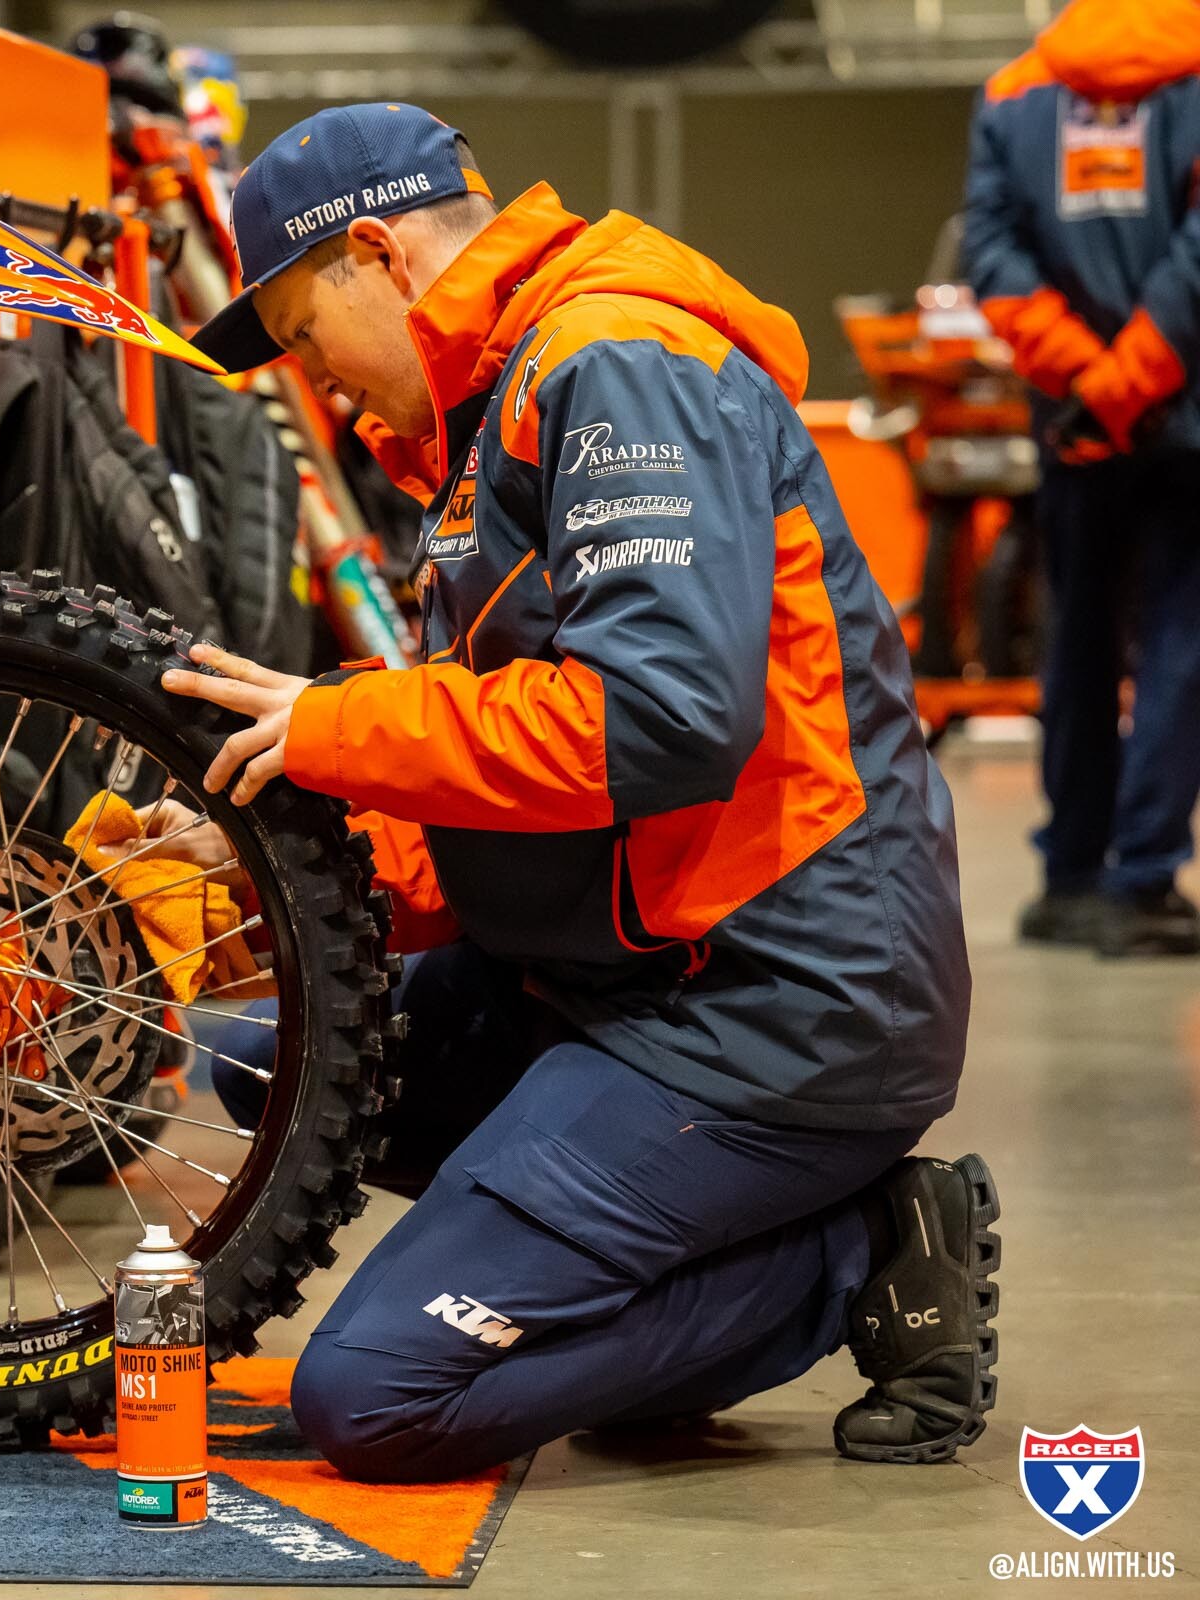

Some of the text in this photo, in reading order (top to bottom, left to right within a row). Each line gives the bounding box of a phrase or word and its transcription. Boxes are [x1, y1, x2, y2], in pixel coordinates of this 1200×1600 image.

[284, 172, 432, 240] FACTORY RACING
[558, 422, 685, 475] PARADISE
[588, 460, 685, 478] CHEVROLET CADILLAC
[596, 496, 692, 517] RENTHAL
[637, 508, 689, 516] CHAMPIONSHIPS
[428, 537, 458, 554] FACTORY
[422, 1293, 524, 1348] KTM
[120, 1352, 202, 1373] MOTO SHINE
[120, 1372, 157, 1400] MS1
[121, 1401, 177, 1412] SHINE AND PROTECT
[141, 1414, 159, 1422] STREET
[122, 1494, 159, 1505] MOTOREX
[184, 1486, 205, 1499] KTM
